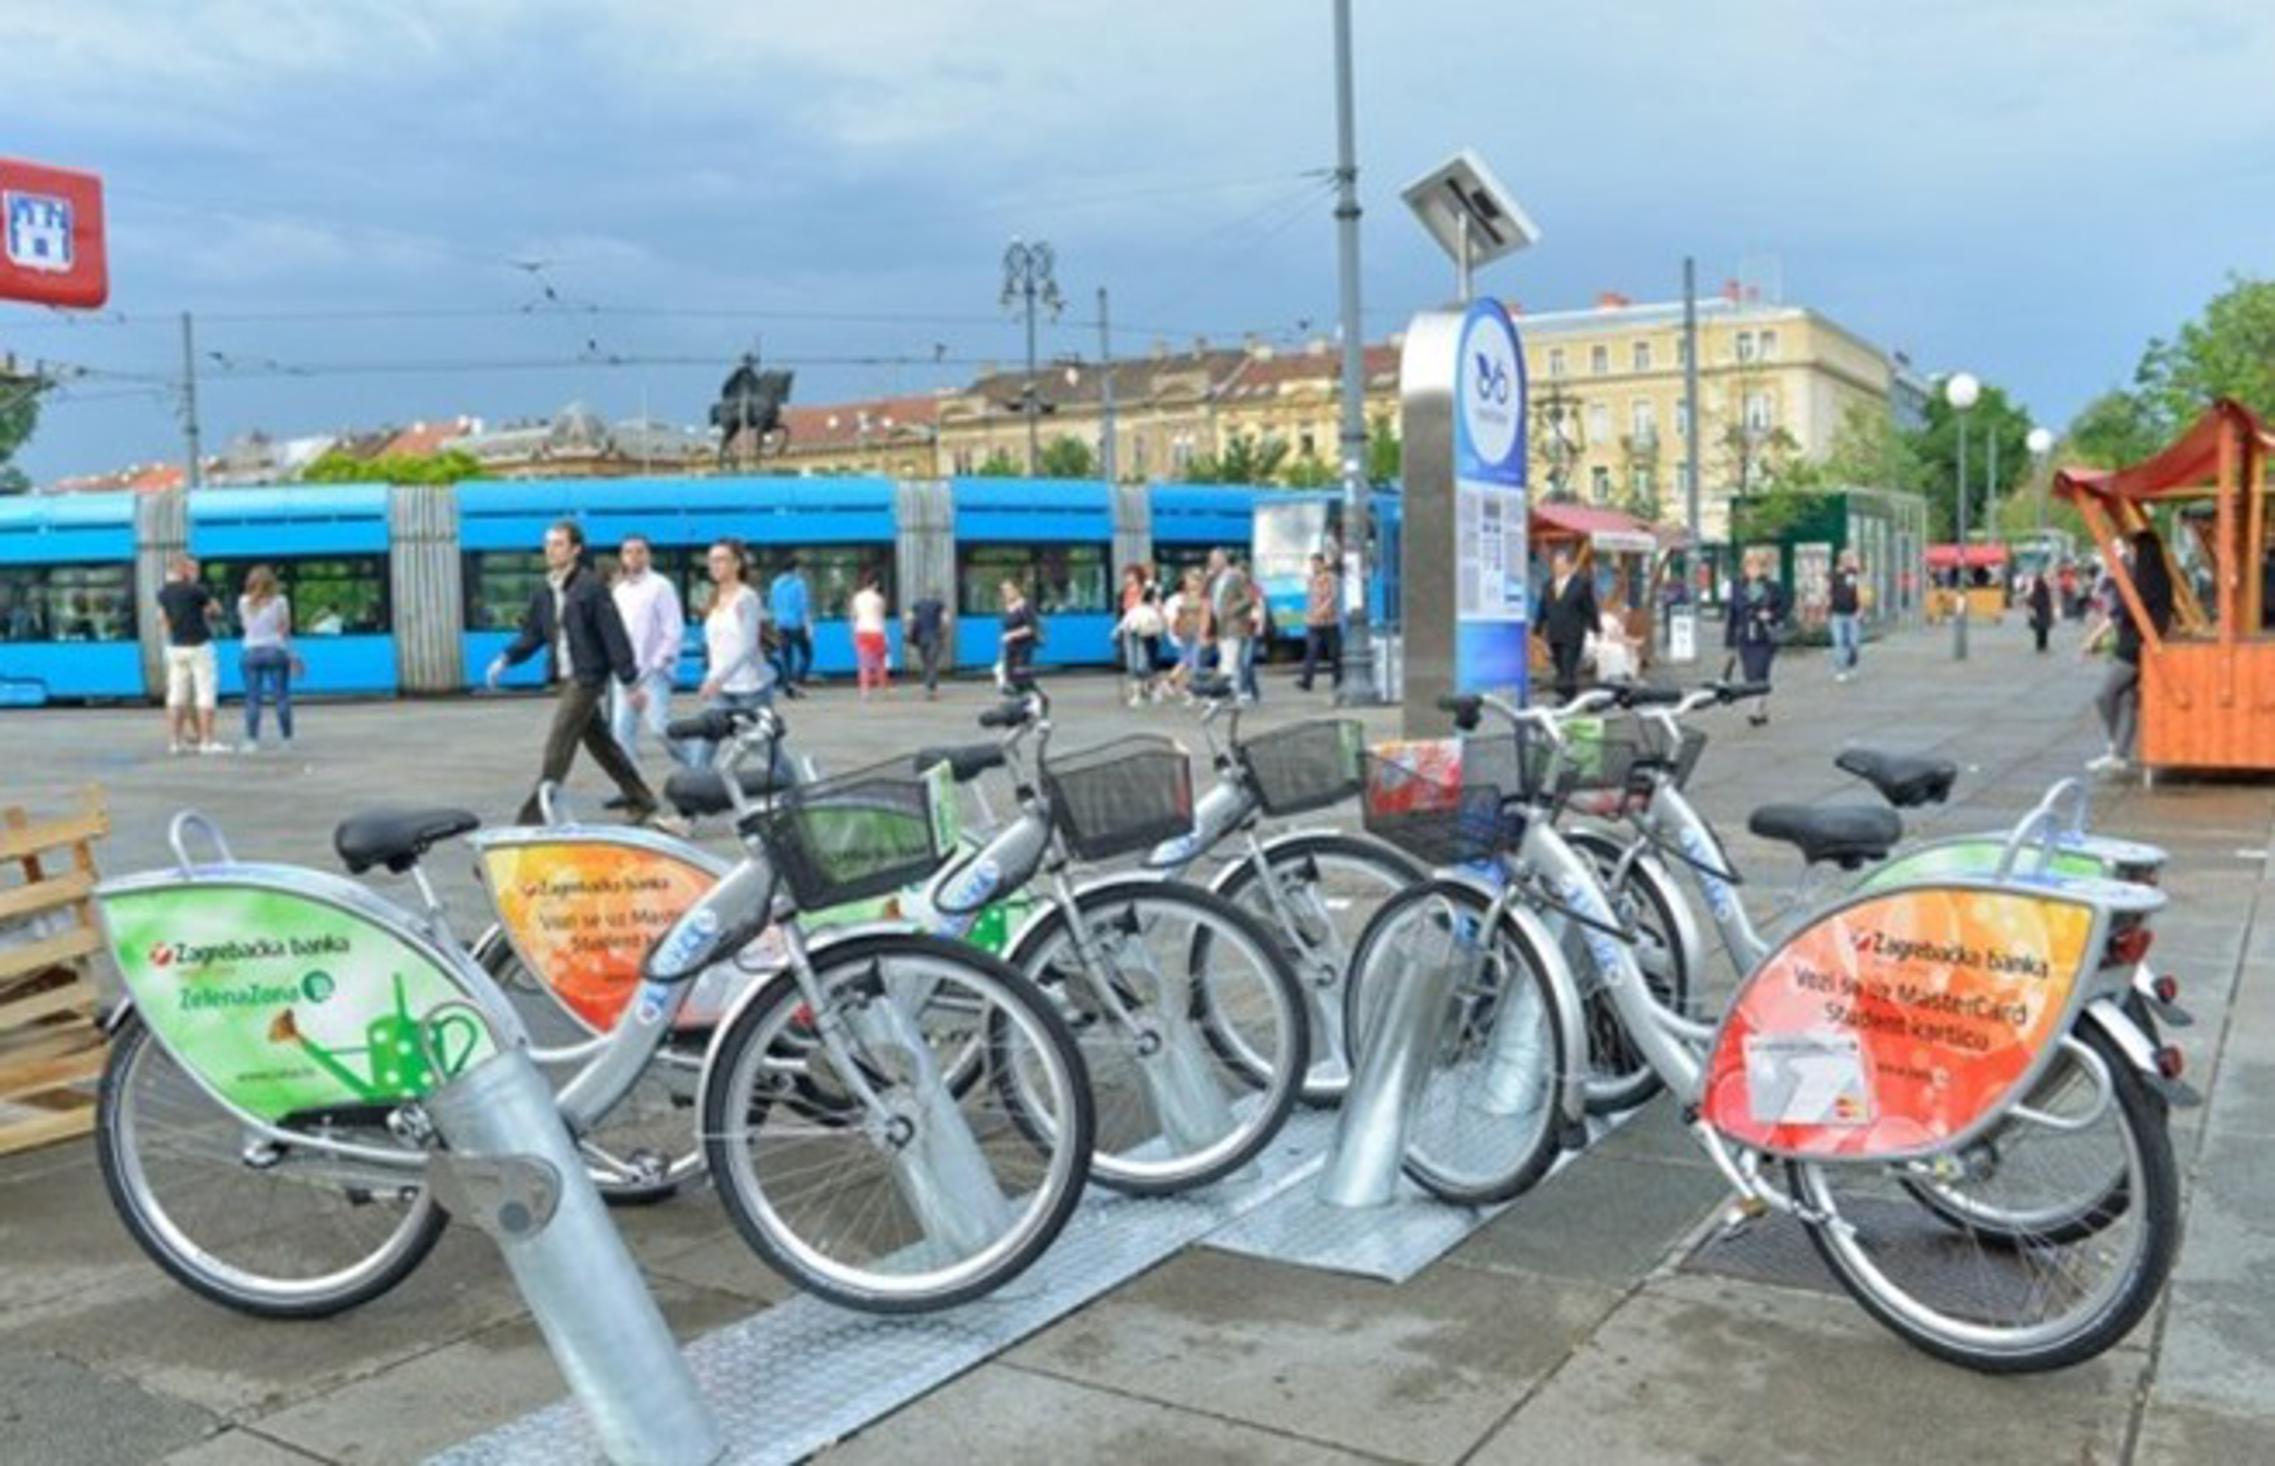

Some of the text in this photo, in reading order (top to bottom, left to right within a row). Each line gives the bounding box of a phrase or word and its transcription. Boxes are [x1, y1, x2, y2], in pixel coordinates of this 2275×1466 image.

[290, 934, 350, 957] banka
[1987, 949, 2049, 980] banka
[1795, 966, 1835, 993] Vozi
[1841, 974, 1863, 998] se
[1896, 984, 2028, 1025] MasterCard
